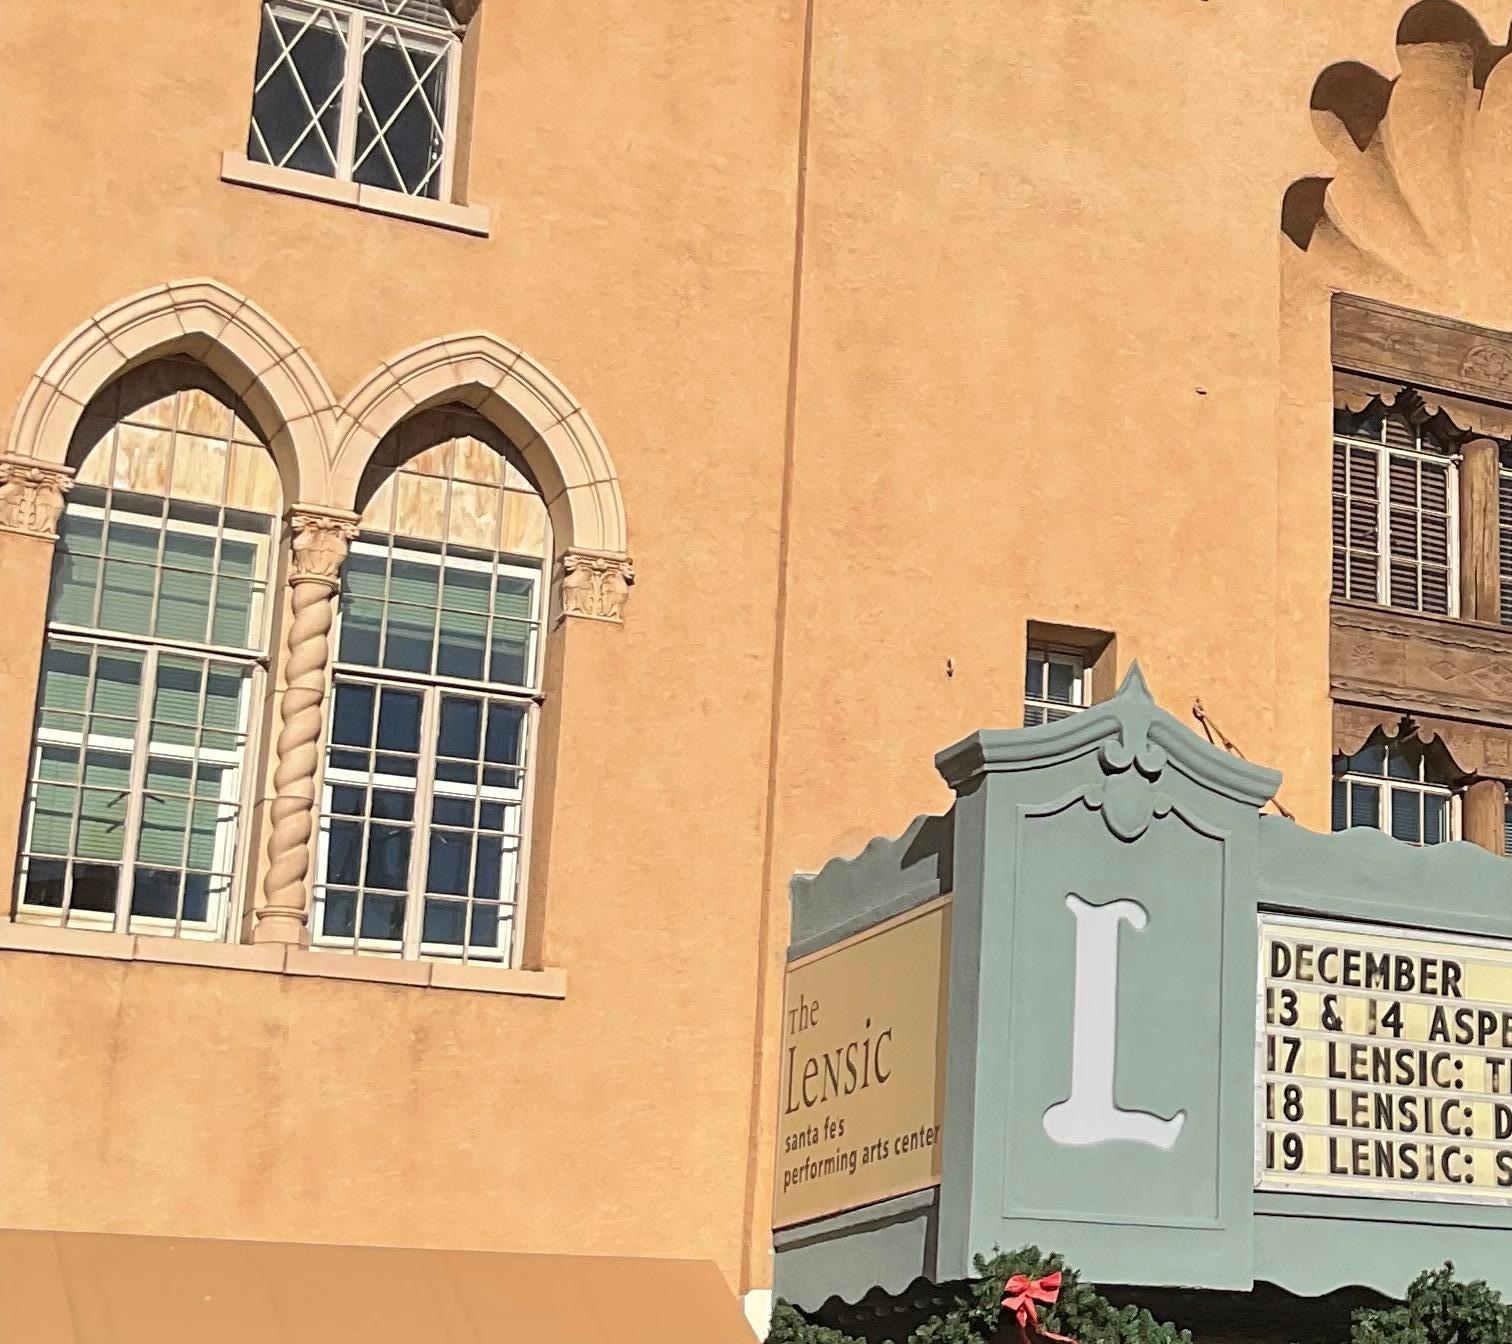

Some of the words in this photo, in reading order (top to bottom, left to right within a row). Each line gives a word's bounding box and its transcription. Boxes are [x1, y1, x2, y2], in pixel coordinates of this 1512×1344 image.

[1270, 940, 1462, 998] DECEMBER
[788, 993, 819, 1035] The
[1266, 987, 1299, 1027] 13
[1321, 994, 1342, 1031] &
[1368, 1000, 1404, 1037] 14
[1266, 1035, 1301, 1074] 17
[1328, 1042, 1464, 1091] LENSIC:
[1266, 1082, 1303, 1123] 18
[1329, 1088, 1473, 1137] LENSIC:
[783, 1148, 857, 1193] performing
[862, 1138, 889, 1164] arts
[894, 1124, 941, 1156] center
[785, 1123, 819, 1154] santa
[1266, 1131, 1303, 1171] 19
[1329, 1135, 1473, 1184] LENSIC:
